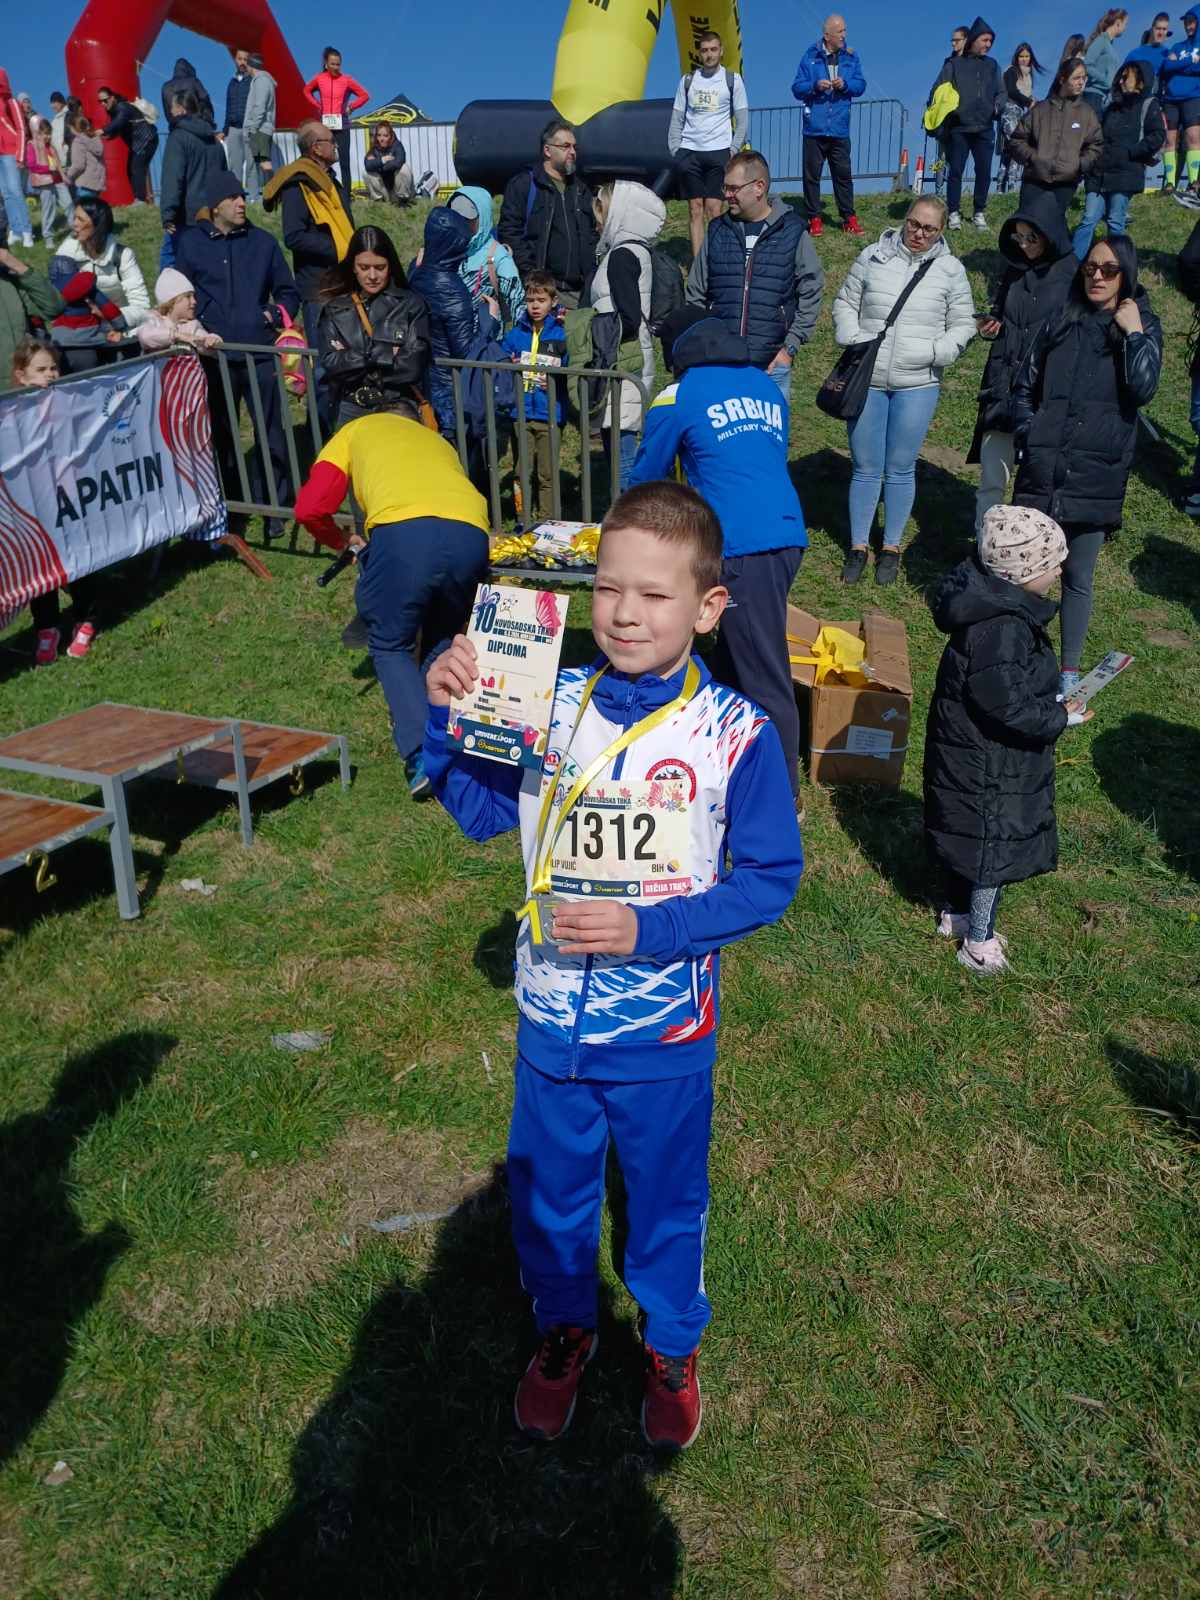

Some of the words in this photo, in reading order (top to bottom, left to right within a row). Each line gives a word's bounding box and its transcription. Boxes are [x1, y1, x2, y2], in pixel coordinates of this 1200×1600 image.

[716, 424, 757, 442] MILITARY
[56, 452, 164, 528] APATIN
[487, 639, 527, 658] DIPLOMA
[566, 811, 656, 860] 1312
[651, 863, 665, 873] BIH
